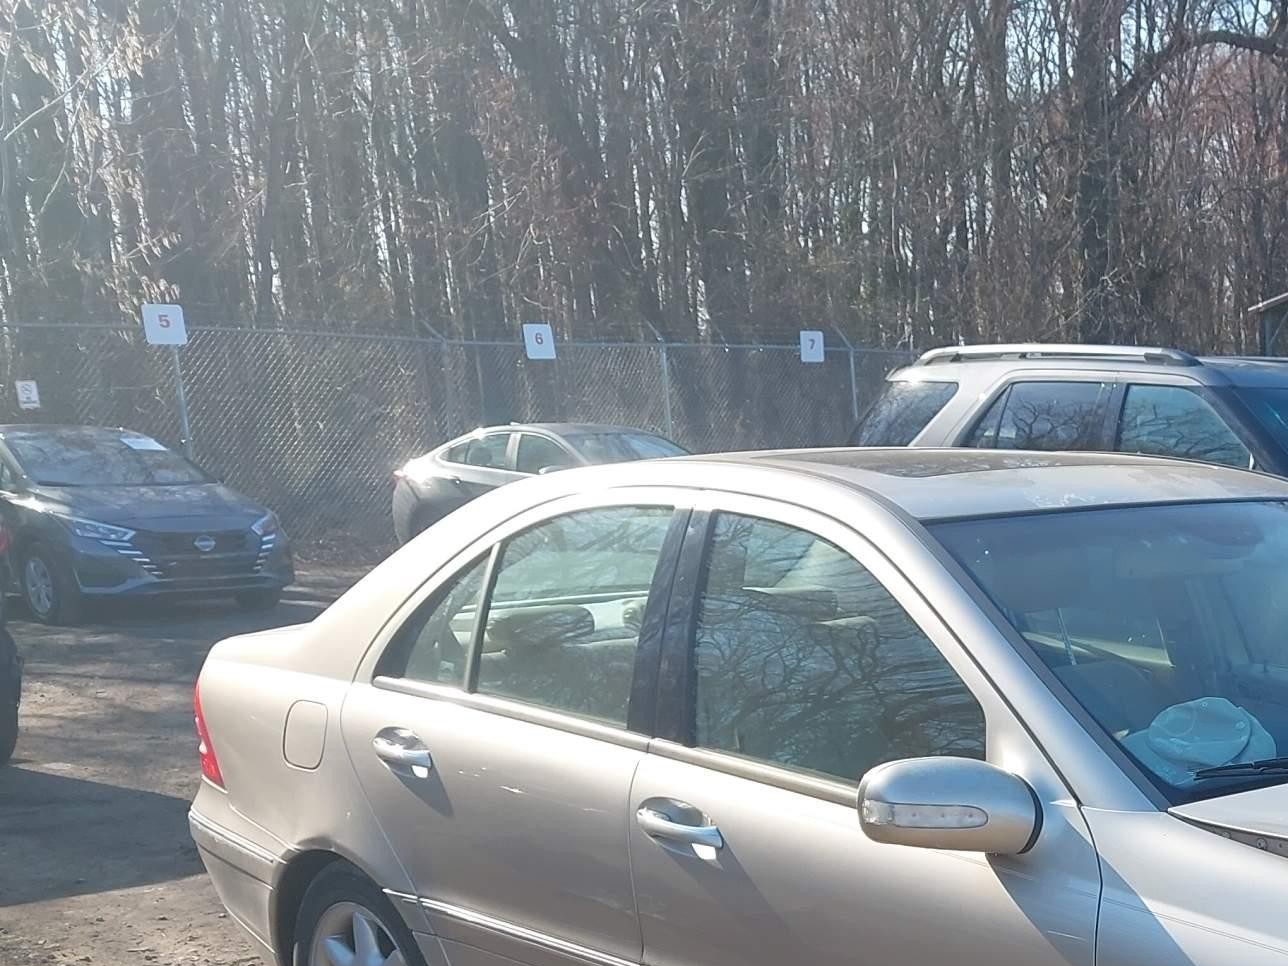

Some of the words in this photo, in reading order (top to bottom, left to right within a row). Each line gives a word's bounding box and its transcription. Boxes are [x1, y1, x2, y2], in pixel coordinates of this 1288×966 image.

[158, 314, 170, 328] 5
[535, 332, 544, 345] 6
[808, 338, 816, 350] 7
